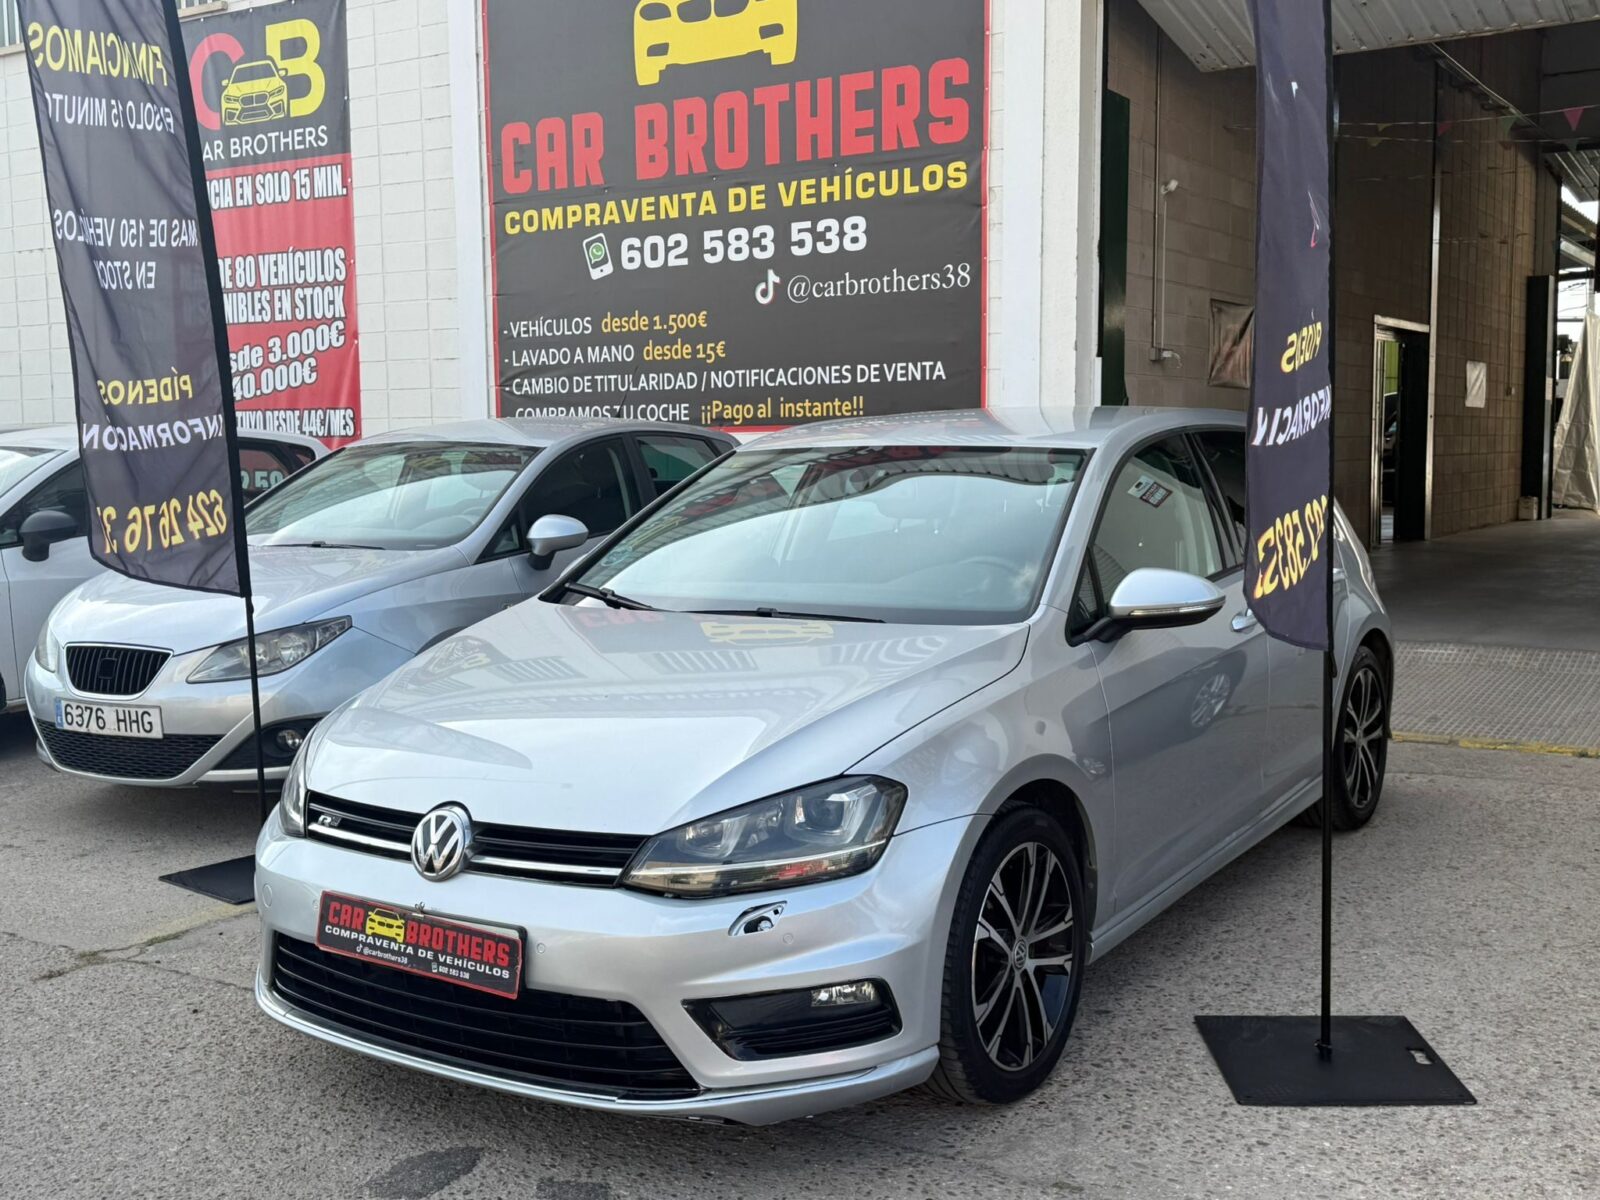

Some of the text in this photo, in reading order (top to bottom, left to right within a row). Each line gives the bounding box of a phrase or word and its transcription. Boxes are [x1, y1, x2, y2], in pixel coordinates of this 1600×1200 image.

[203, 125, 328, 161] AR BROTHERS
[501, 57, 970, 195] CAR BROTHERS
[206, 164, 347, 210] CIA EN SOLO 15 MIN.
[504, 161, 968, 235] COMPRAVENTA DE VEHÍCULOS
[621, 215, 867, 270] 602 583 538
[235, 256, 256, 288] 80
[258, 246, 346, 287] VEHÍCULOS
[787, 263, 971, 304] @carbrothers38
[223, 285, 345, 324] NIBLES EN STOCK
[601, 310, 649, 333] desde
[653, 311, 708, 335] 1.500€
[230, 320, 345, 373] sde 3.000€
[512, 349, 571, 367] LAVADO
[573, 347, 585, 364] A
[587, 345, 635, 363] MANO
[643, 338, 692, 361] desde
[696, 341, 726, 364] 15€
[512, 377, 569, 396] CAMBIO
[573, 376, 592, 394] DE
[595, 371, 698, 393] TITULARIDAD
[710, 364, 852, 389] NOTIFICACIONES
[856, 363, 880, 383] DE
[883, 361, 947, 383] VENTA
[266, 410, 300, 434] DESDE
[302, 409, 354, 437] 44€/MES
[637, 404, 690, 421] COCHE
[701, 399, 753, 426] ¡¡Pago
[757, 398, 771, 418] al
[780, 395, 864, 418] instante!!
[64, 704, 153, 733] 6376 HHG
[325, 925, 510, 979] COMPRAVENTA DE VEHÍCULOS
[328, 901, 510, 967] CAR BROTHERS
